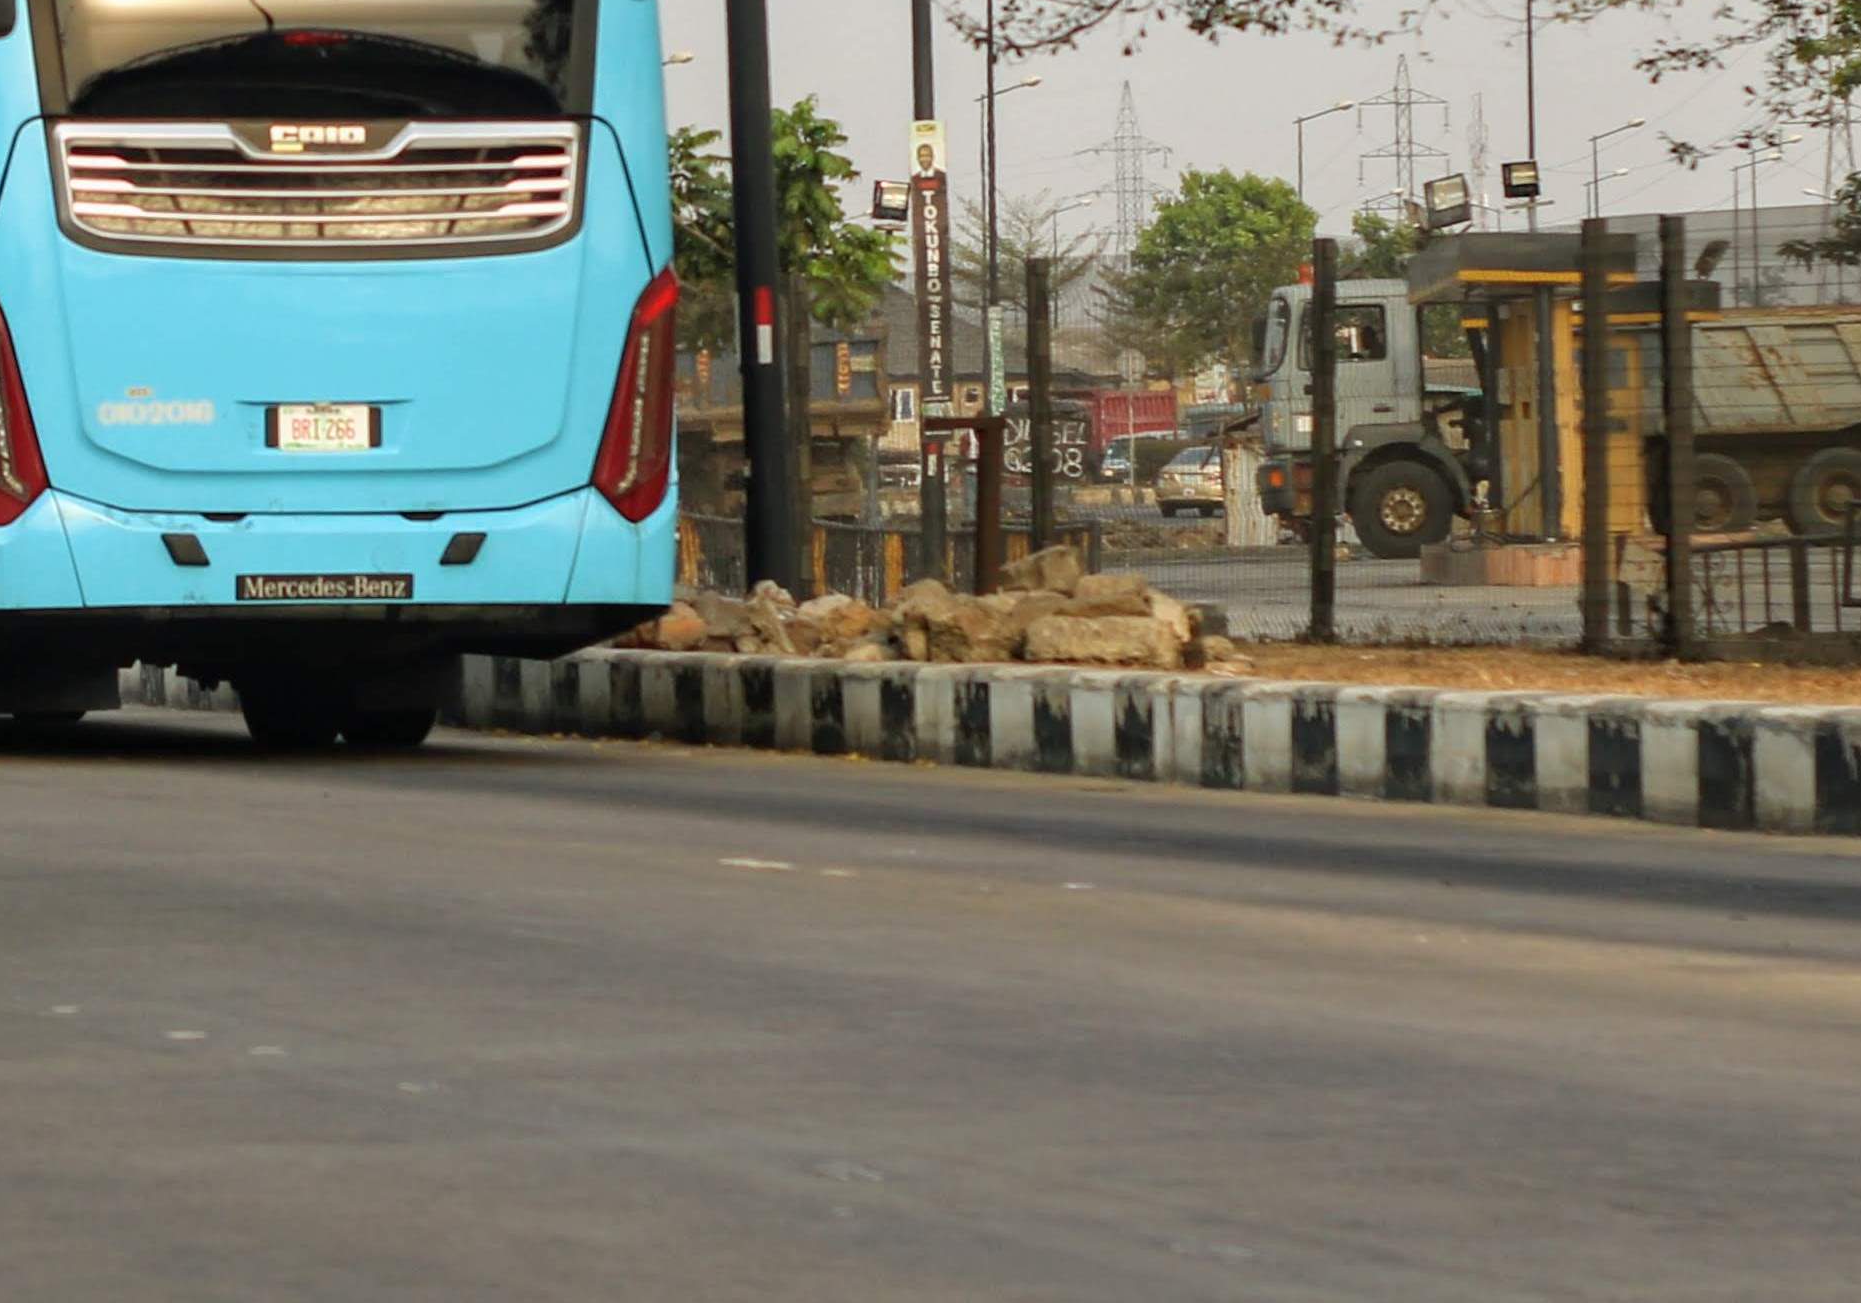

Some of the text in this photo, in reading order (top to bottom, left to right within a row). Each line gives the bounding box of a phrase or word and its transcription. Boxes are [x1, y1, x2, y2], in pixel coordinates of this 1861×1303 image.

[921, 189, 942, 293] TOKUNBO
[929, 304, 943, 395] SENATE
[243, 576, 407, 599] Mercedes-Benz
